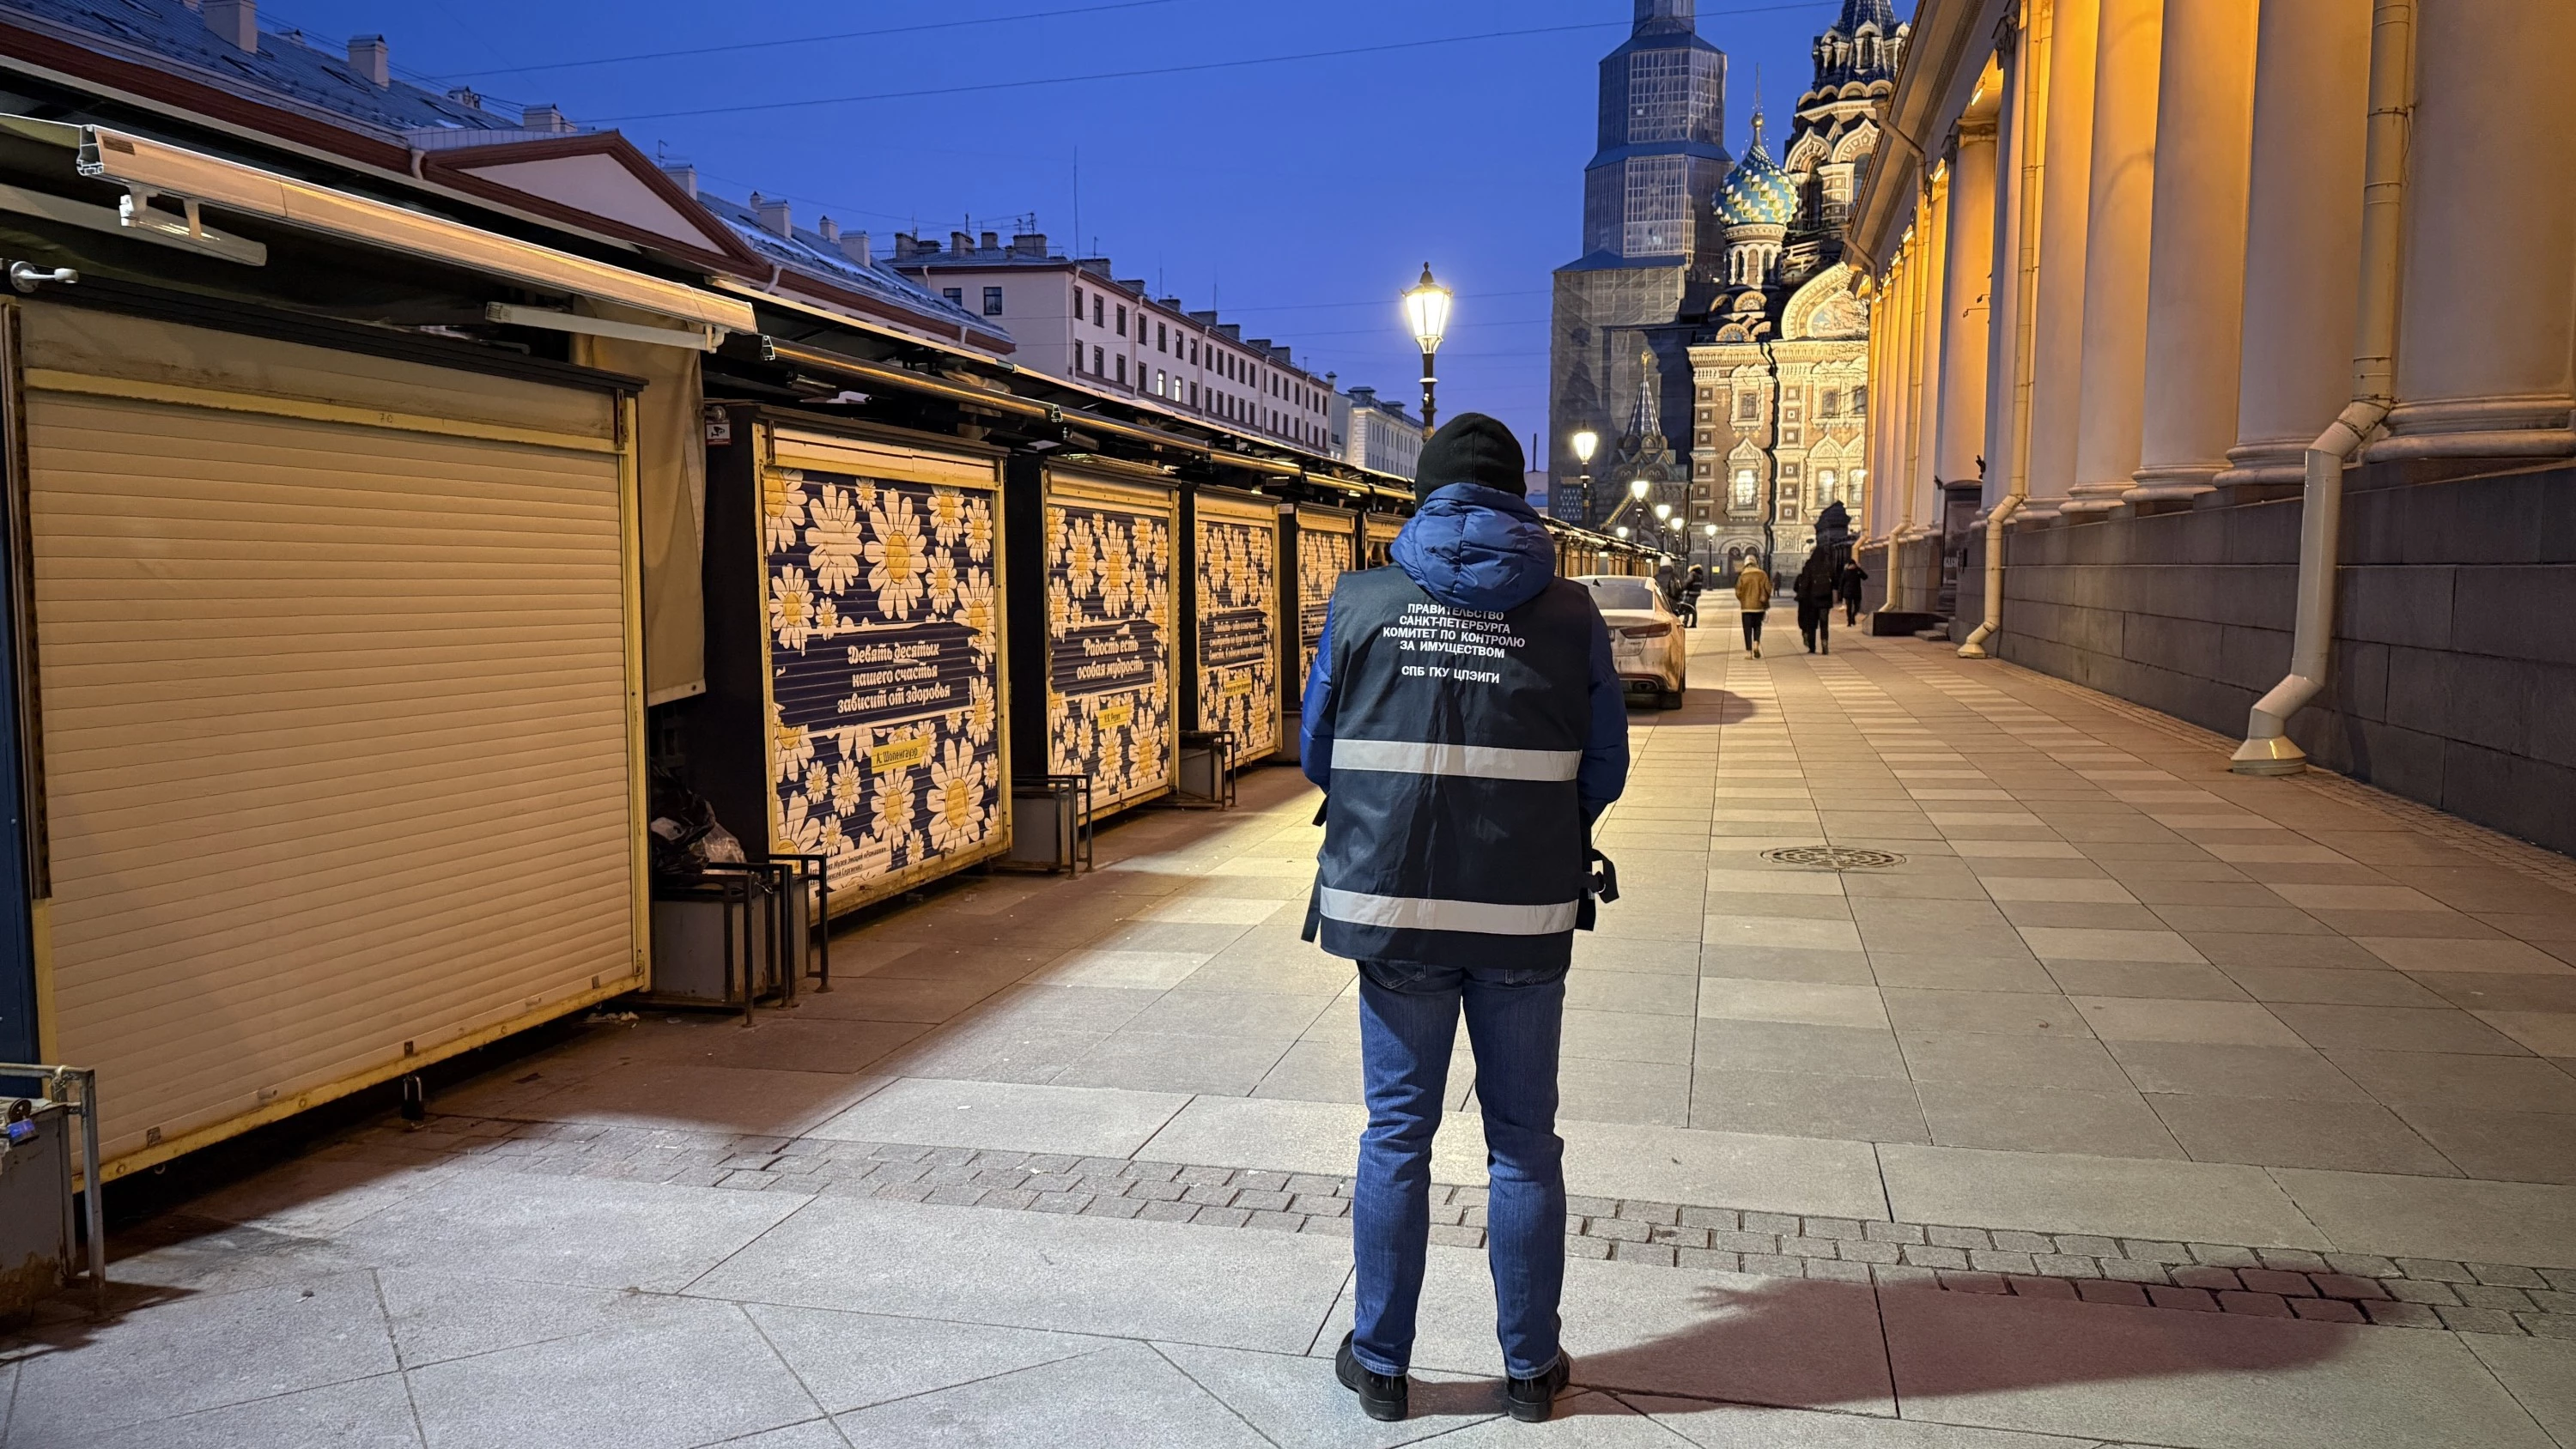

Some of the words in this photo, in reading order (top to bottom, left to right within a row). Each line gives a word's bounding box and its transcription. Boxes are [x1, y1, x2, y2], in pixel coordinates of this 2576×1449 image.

[1407, 603, 1504, 621] ПРАВИТЕЛЬСТВО
[1399, 615, 1511, 634] САНКТ-ПЕТЕРБУРГА
[1082, 637, 1119, 658] Радость
[1120, 634, 1139, 652] есть
[1382, 626, 1437, 639] КОМИТЕТ
[1440, 629, 1456, 640] ПО
[1461, 631, 1526, 648] КОНТРОЛЮ
[847, 643, 893, 665] Девять
[893, 640, 940, 661] десятых
[1399, 640, 1415, 651] ЗА
[1420, 640, 1505, 659] ИМУЩЕСТВОМ
[852, 670, 894, 688] нашего
[894, 662, 938, 683] счастья
[1076, 660, 1106, 680] особая
[1106, 655, 1145, 680] мудрость
[1400, 665, 1425, 677] СПБ
[1429, 666, 1450, 678] ГКУ
[1453, 668, 1501, 684] ЦПЭИГИ
[837, 689, 887, 714] зависит
[888, 687, 905, 706] от
[906, 682, 951, 706] здоровья
[883, 746, 918, 763] Шопенгауэр
